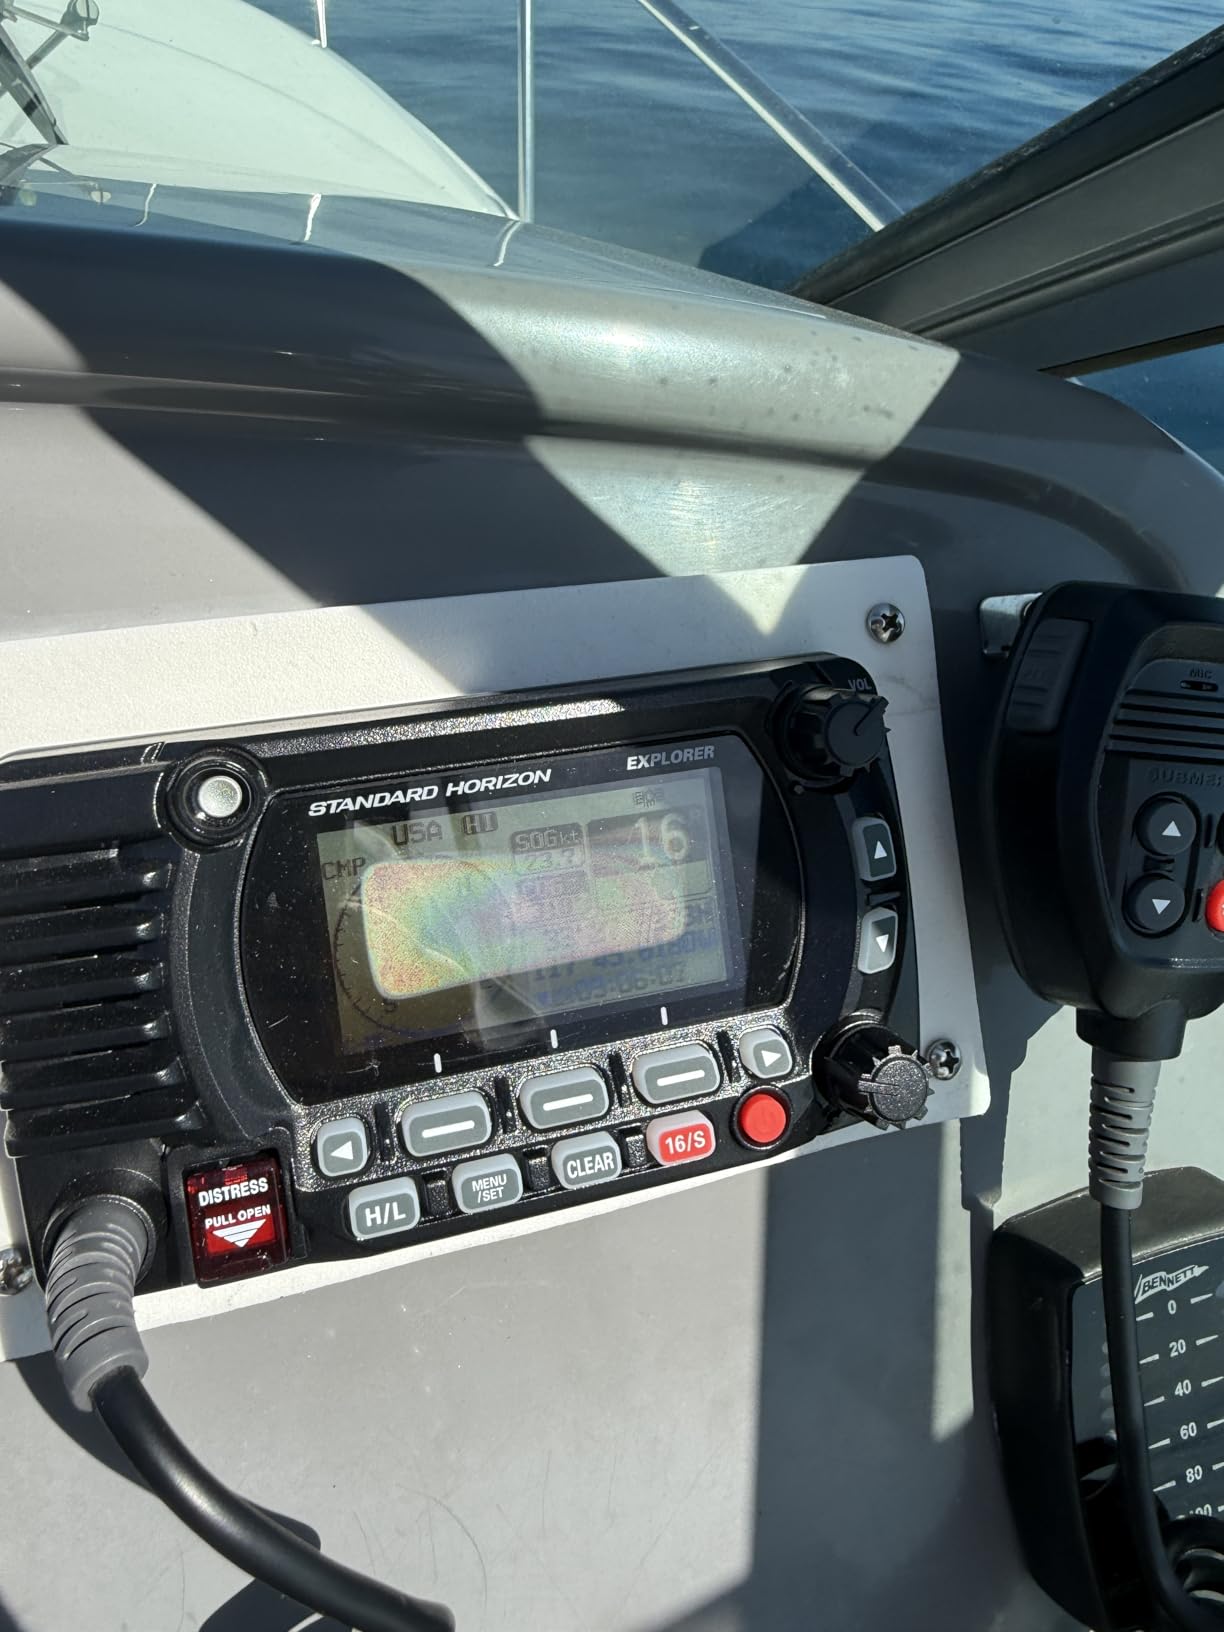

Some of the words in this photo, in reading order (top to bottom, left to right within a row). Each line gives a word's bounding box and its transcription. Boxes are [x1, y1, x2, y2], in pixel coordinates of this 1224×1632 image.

[847, 678, 872, 692] VOL
[626, 745, 715, 771] EXPLORER
[308, 785, 439, 817] STANDARD
[446, 769, 551, 798] HORIZON
[392, 819, 443, 846] USA
[462, 811, 499, 836] HI
[634, 813, 688, 864] 16
[321, 857, 367, 881] CMP
[664, 1130, 707, 1156] 16/S
[567, 1151, 614, 1178] CLEAR
[198, 1177, 269, 1207] DISTRESS
[471, 1173, 508, 1193] MENU
[477, 1186, 505, 1205] /SET
[204, 1211, 237, 1231] PULL
[237, 1203, 271, 1223] OPEN
[364, 1202, 407, 1228] H/L
[1142, 1266, 1197, 1294] BENNETT
[1167, 1300, 1176, 1315] 0
[1169, 1340, 1186, 1358] 20
[1174, 1379, 1192, 1397] 40
[1179, 1422, 1198, 1440] 60
[1185, 1465, 1203, 1484] 80
